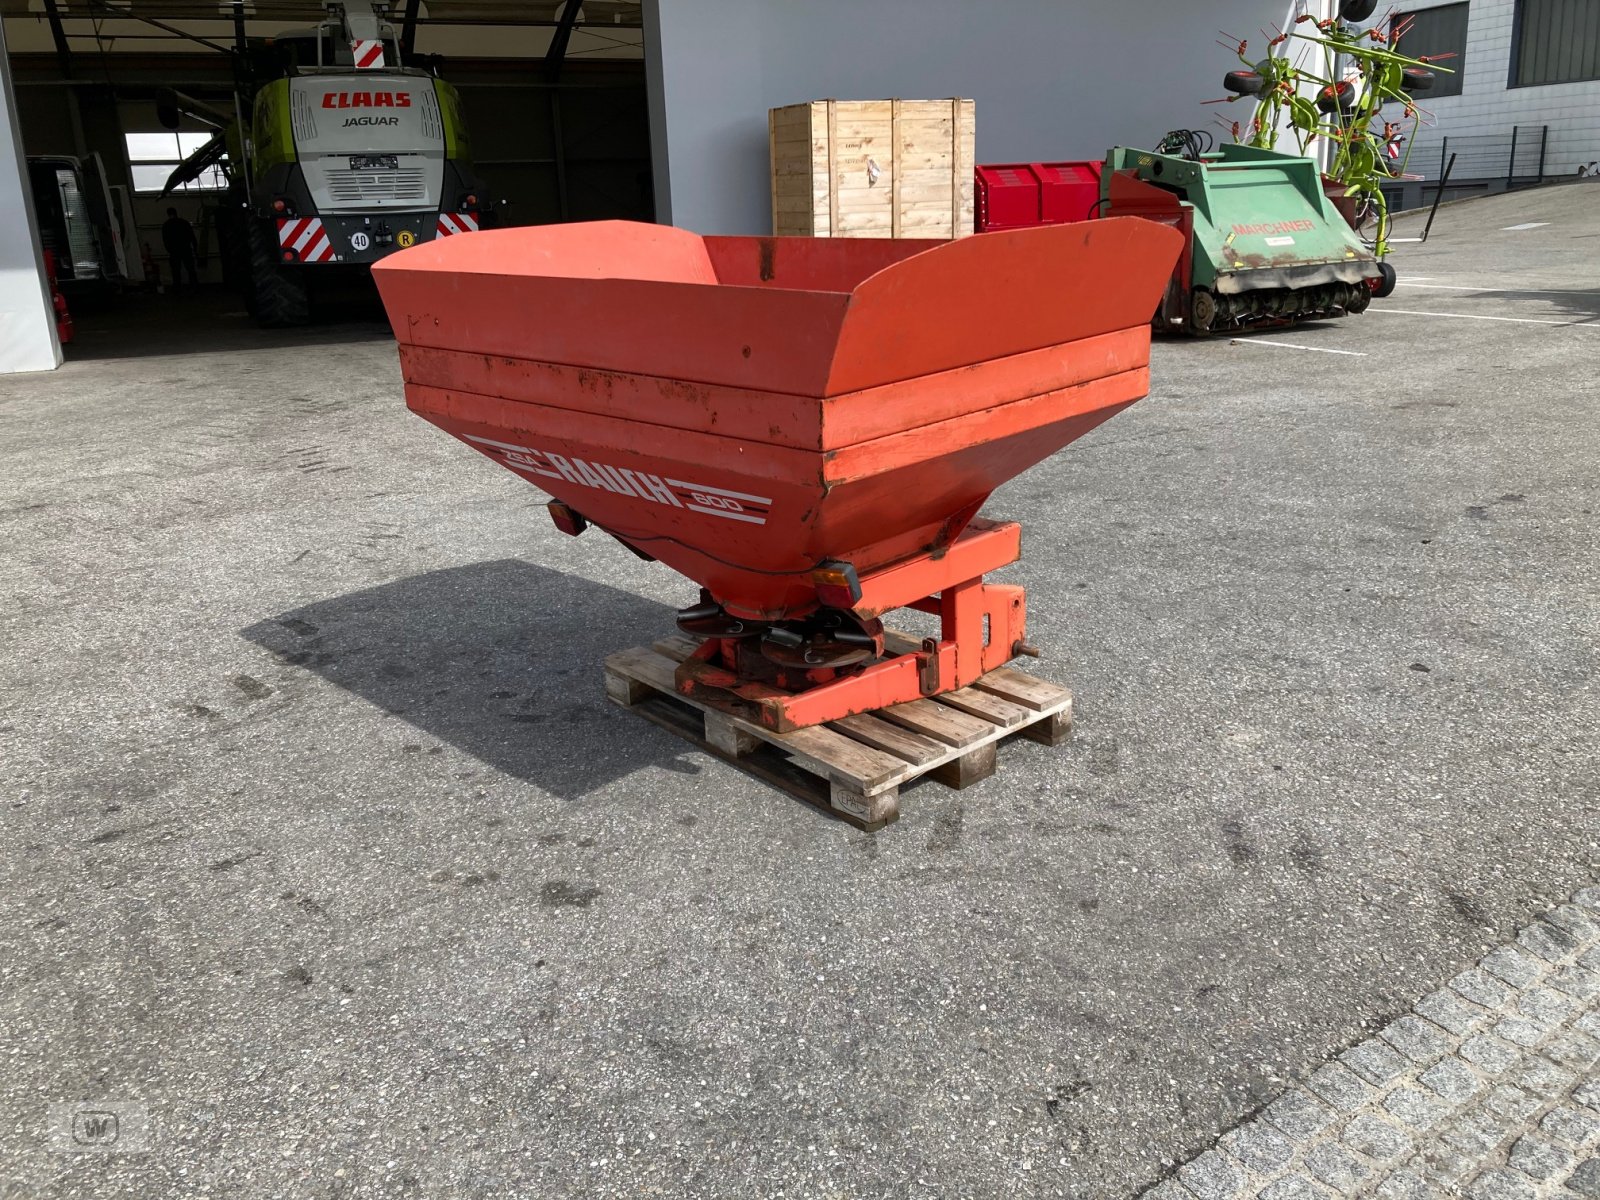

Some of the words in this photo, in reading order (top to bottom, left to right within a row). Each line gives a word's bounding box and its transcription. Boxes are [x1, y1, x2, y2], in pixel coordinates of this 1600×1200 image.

[321, 92, 411, 108] CLAAS
[342, 117, 399, 127] JAGUAR
[1231, 219, 1317, 235] MARCHNER
[354, 235, 367, 247] 40
[402, 234, 410, 245] R
[542, 451, 684, 509] RAUCH
